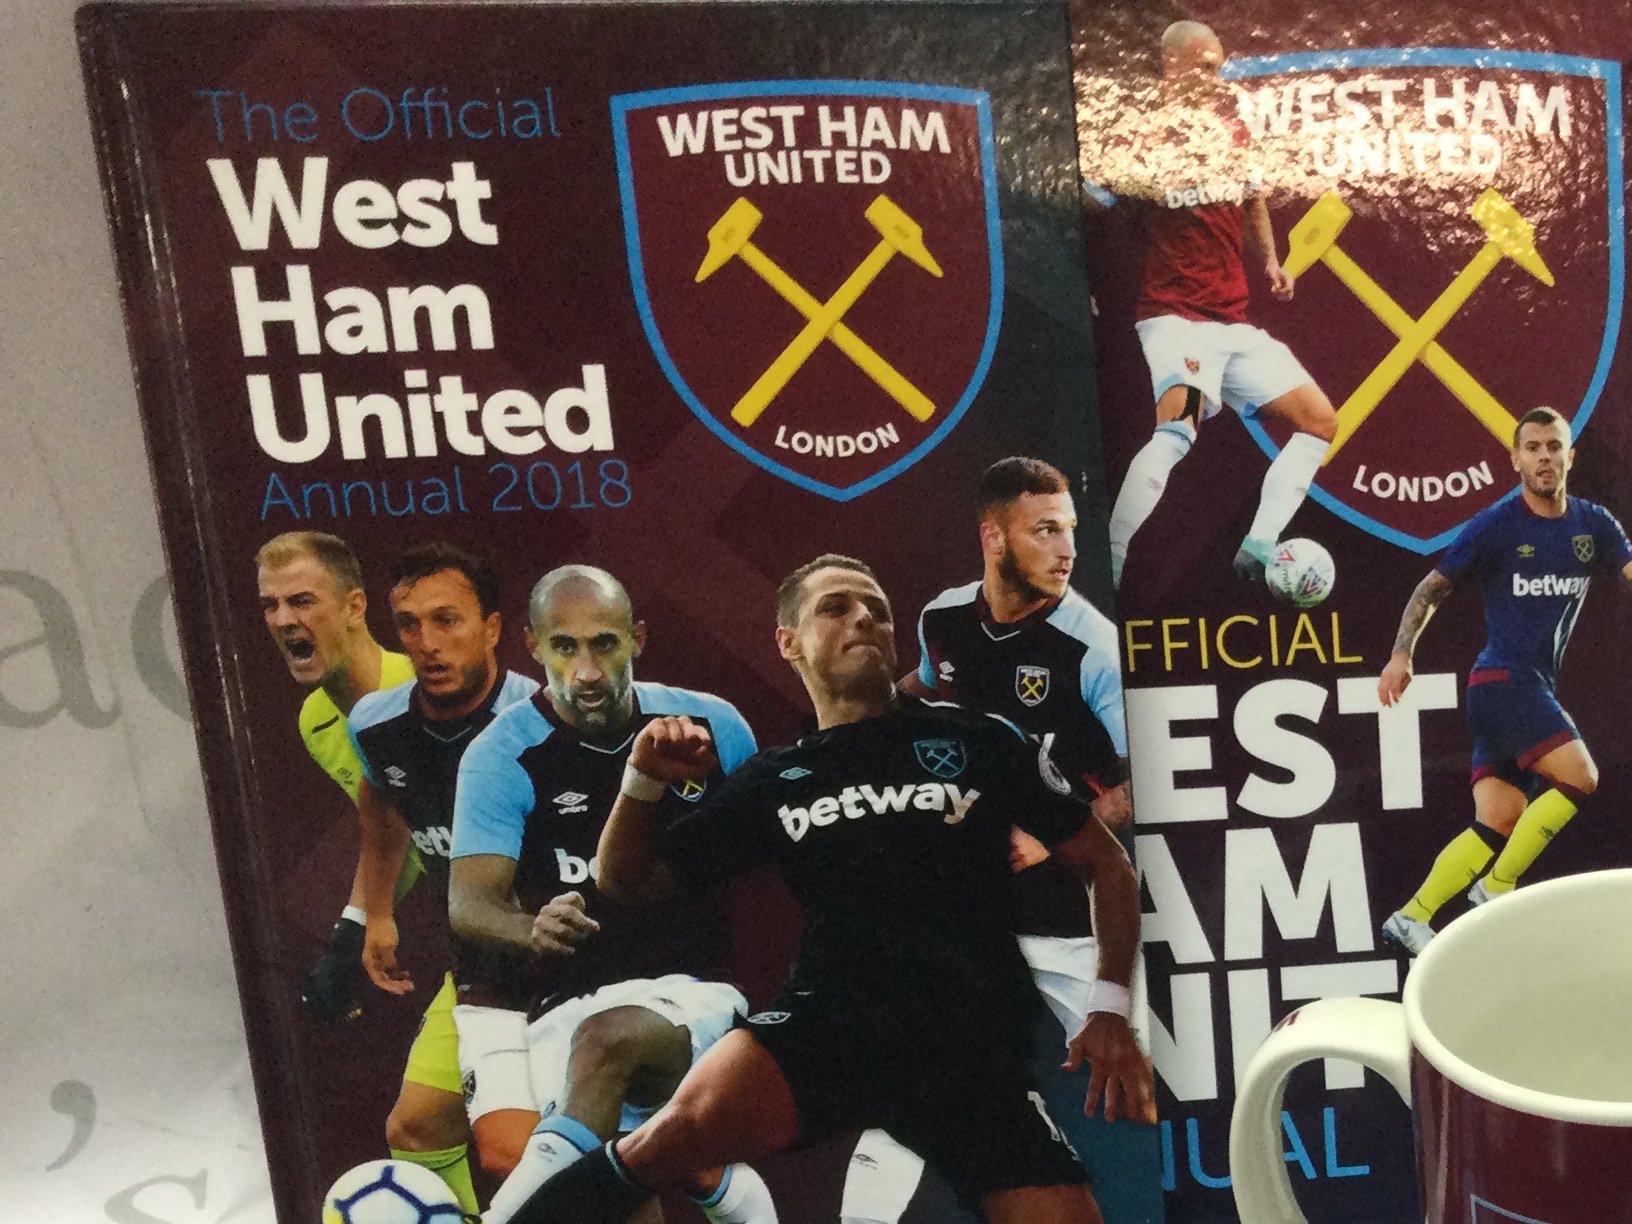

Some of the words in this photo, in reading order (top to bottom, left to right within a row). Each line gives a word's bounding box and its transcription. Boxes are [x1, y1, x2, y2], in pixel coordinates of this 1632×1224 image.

[194, 90, 317, 142] The
[341, 86, 561, 140] Official
[657, 105, 805, 157] WEST
[818, 106, 951, 154] HAM
[1237, 80, 1406, 138] WEST
[1423, 78, 1572, 135] HAM
[724, 150, 892, 187] UNITED
[1309, 133, 1502, 178] UNITED
[206, 157, 499, 251] West
[230, 264, 495, 357] Ham
[246, 364, 614, 464] United
[775, 422, 900, 458] LONDON
[260, 465, 470, 520] Annual
[492, 458, 633, 512] 2018
[1353, 461, 1494, 503] LONDON
[1512, 573, 1590, 598] betway
[1126, 611, 1363, 673] FFICIAL
[1124, 672, 1458, 824] EST
[777, 782, 981, 842] betway
[1134, 822, 1375, 963] AM
